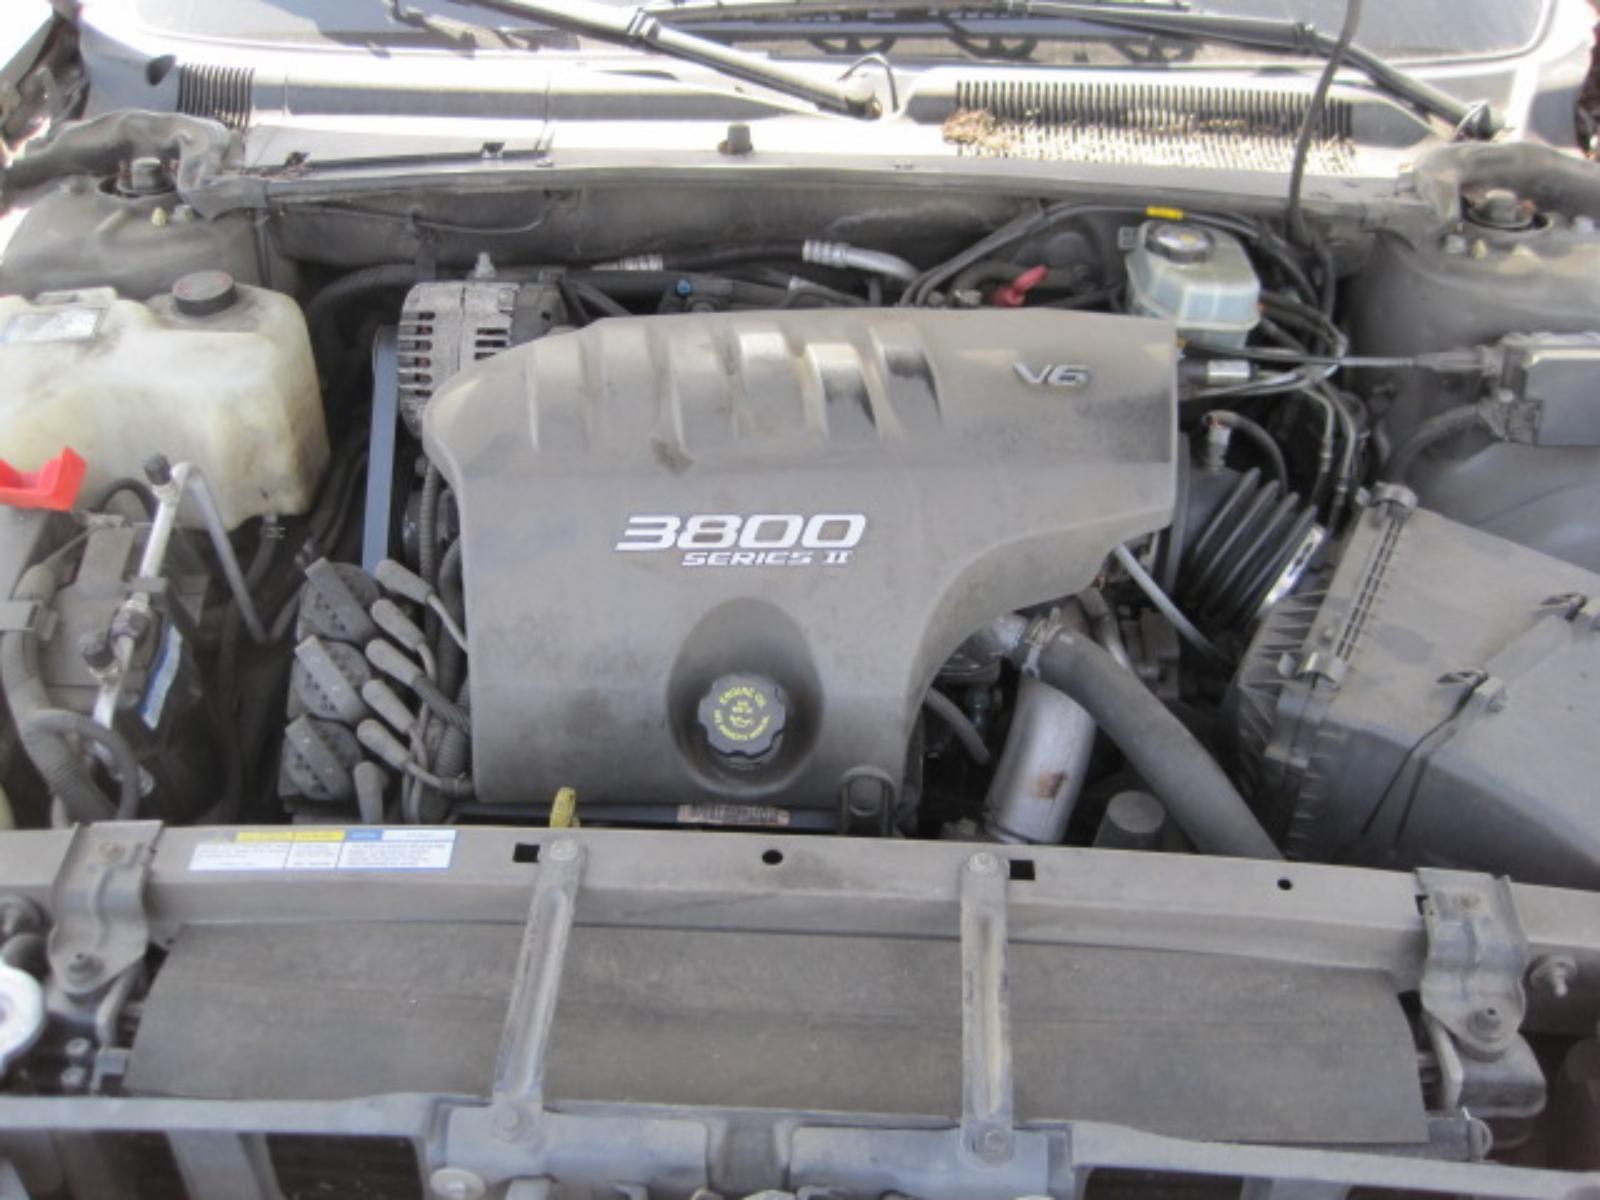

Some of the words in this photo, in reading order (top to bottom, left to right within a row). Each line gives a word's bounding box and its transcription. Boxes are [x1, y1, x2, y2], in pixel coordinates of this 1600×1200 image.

[1012, 363, 1088, 385] V6
[615, 513, 866, 550] 3800
[681, 551, 812, 566] SERIES
